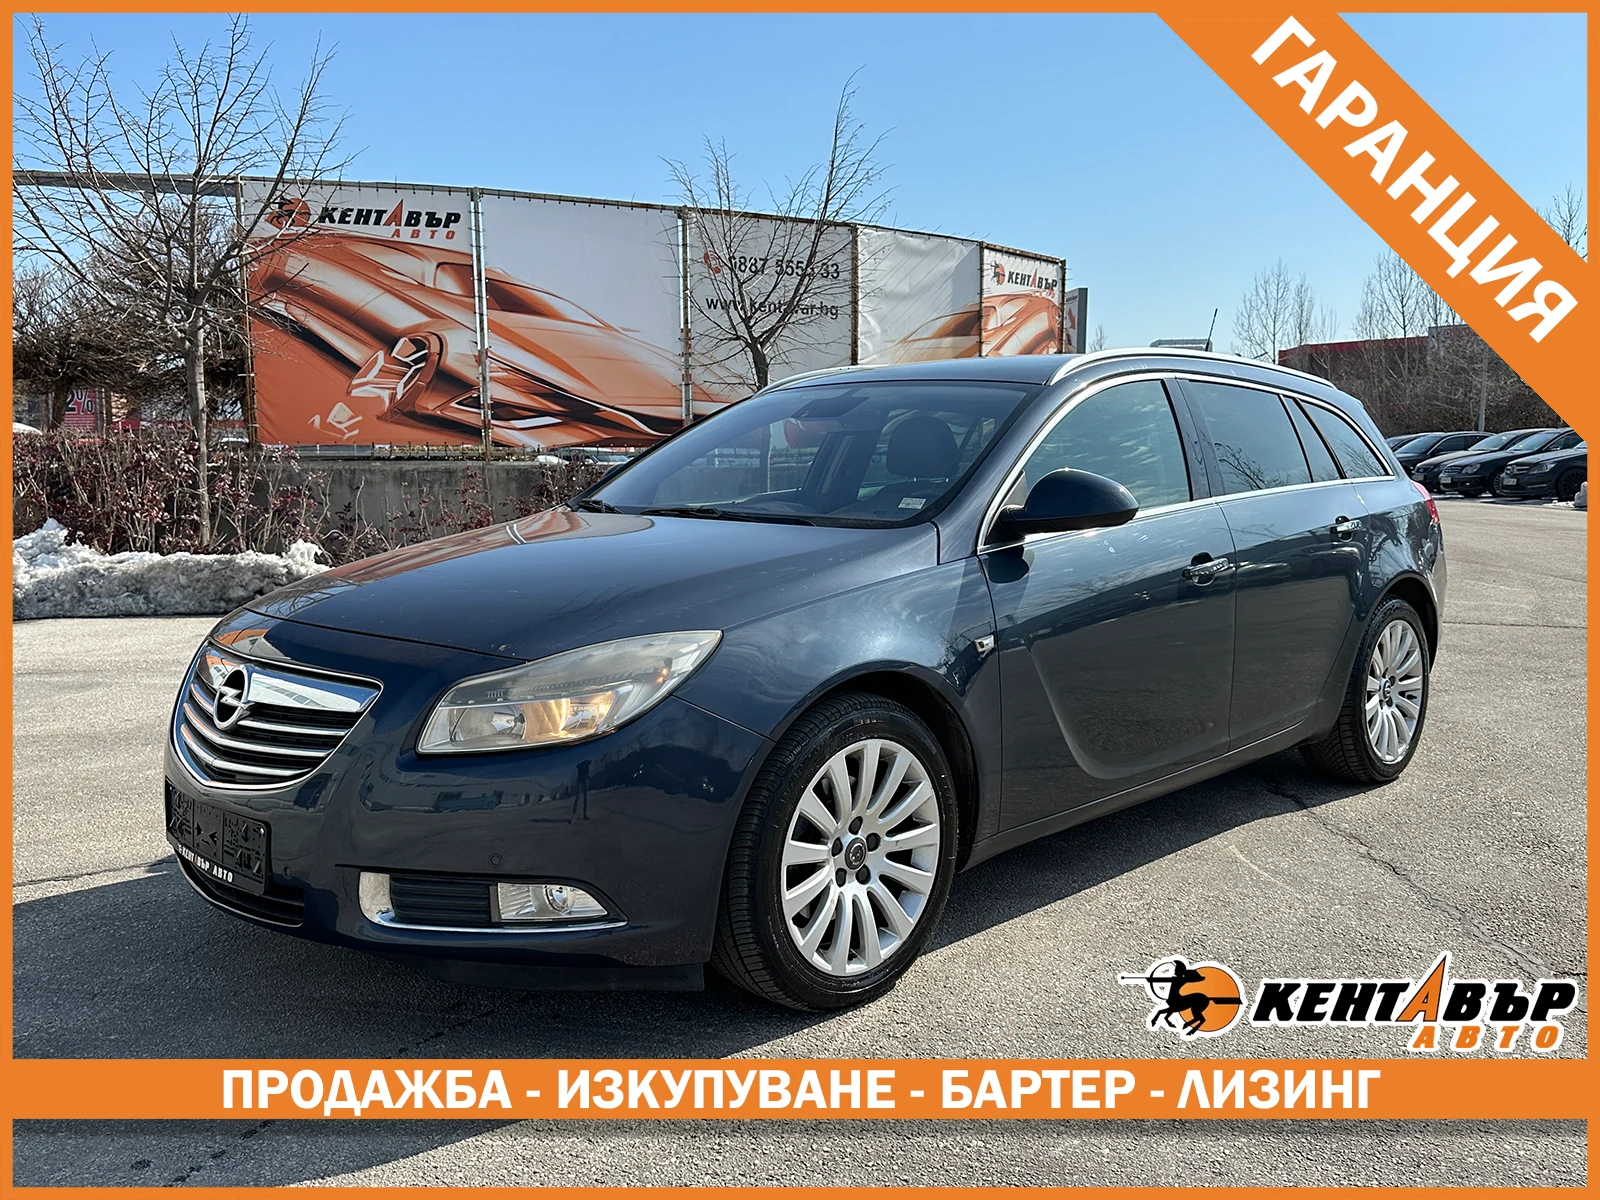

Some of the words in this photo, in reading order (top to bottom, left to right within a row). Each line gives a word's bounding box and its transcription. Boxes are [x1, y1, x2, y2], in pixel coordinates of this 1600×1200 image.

[318, 199, 462, 229] КЕНТАВЪР
[391, 228, 456, 240] АВТО
[1007, 268, 1058, 292] КЕНТАВЪР
[212, 864, 234, 883] АВТО
